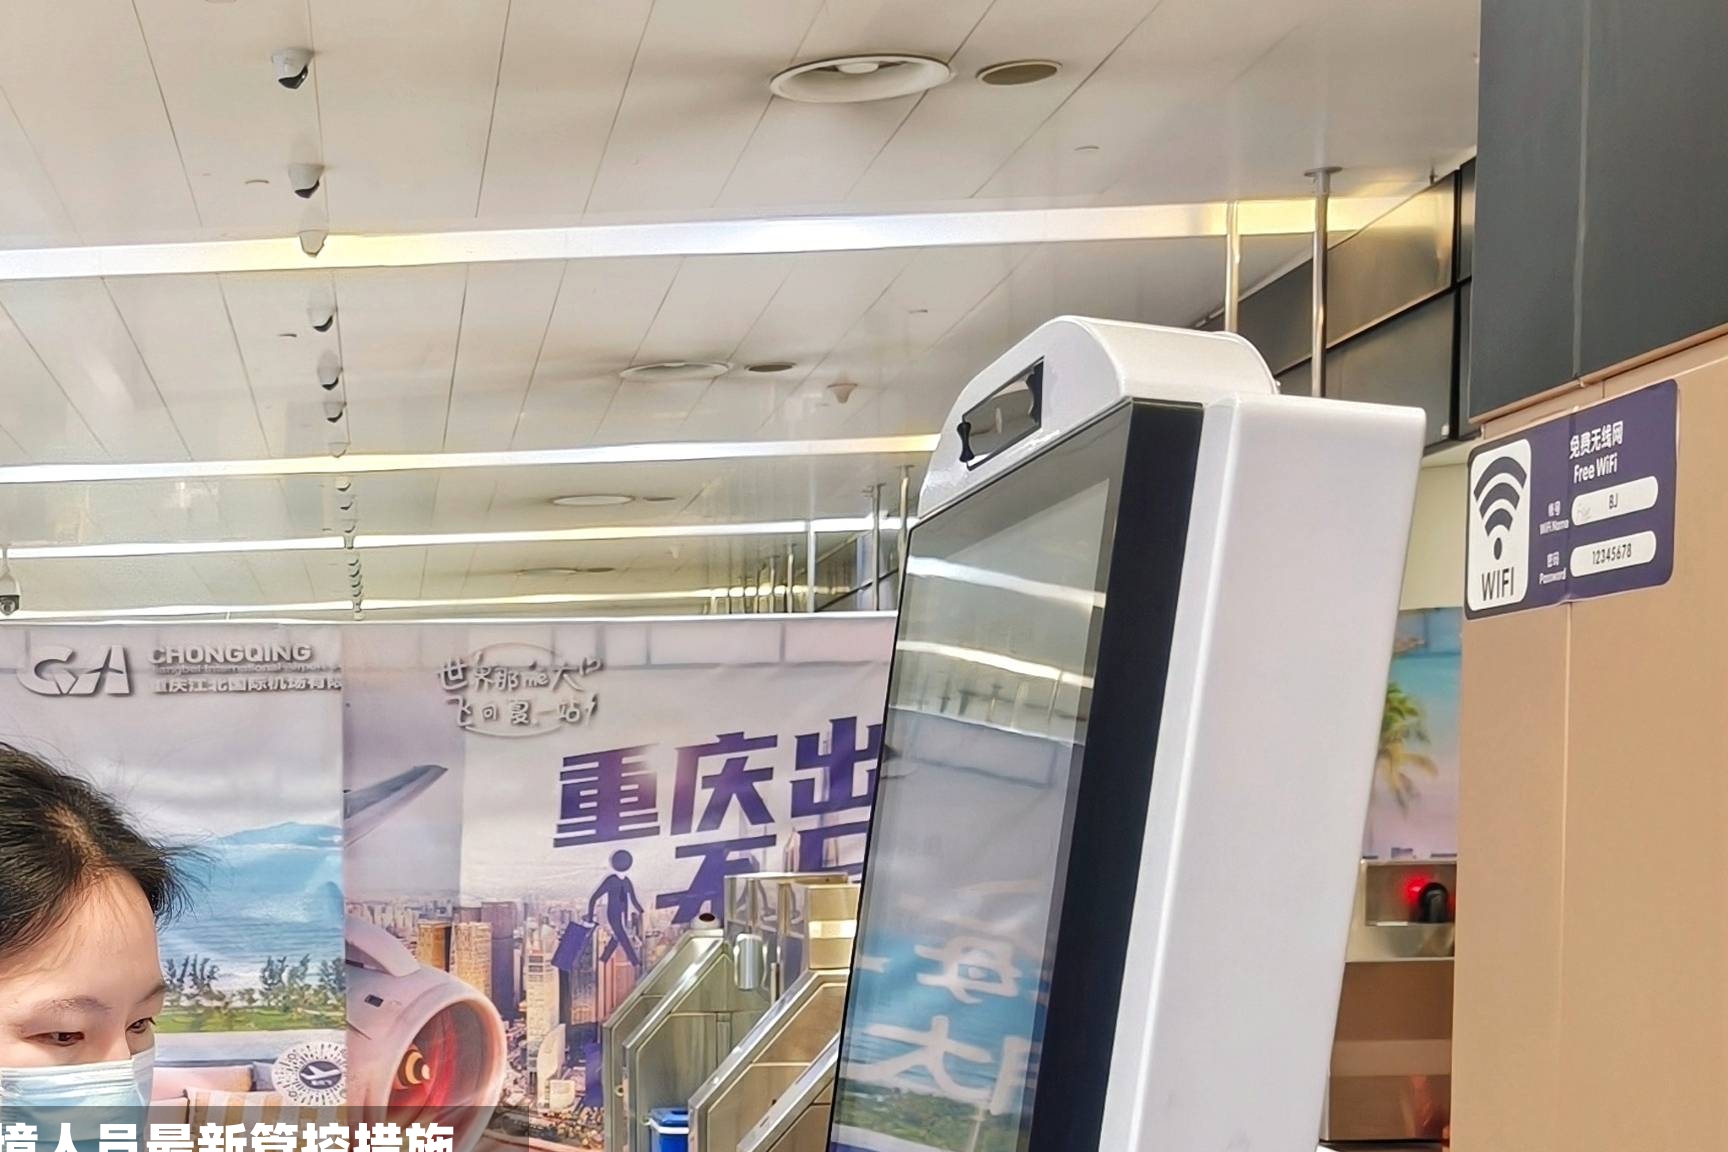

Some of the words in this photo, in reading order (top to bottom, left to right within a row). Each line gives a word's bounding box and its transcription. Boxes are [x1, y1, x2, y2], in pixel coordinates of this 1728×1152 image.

[1569, 420, 1624, 460] 免费无线网
[1573, 463, 1595, 484] Free
[1596, 452, 1618, 477] WiFi
[1592, 543, 1632, 565] 12345678
[1481, 567, 1515, 601] WIFI
[149, 643, 313, 663] CHONGQING
[553, 716, 881, 848] 重庆出
